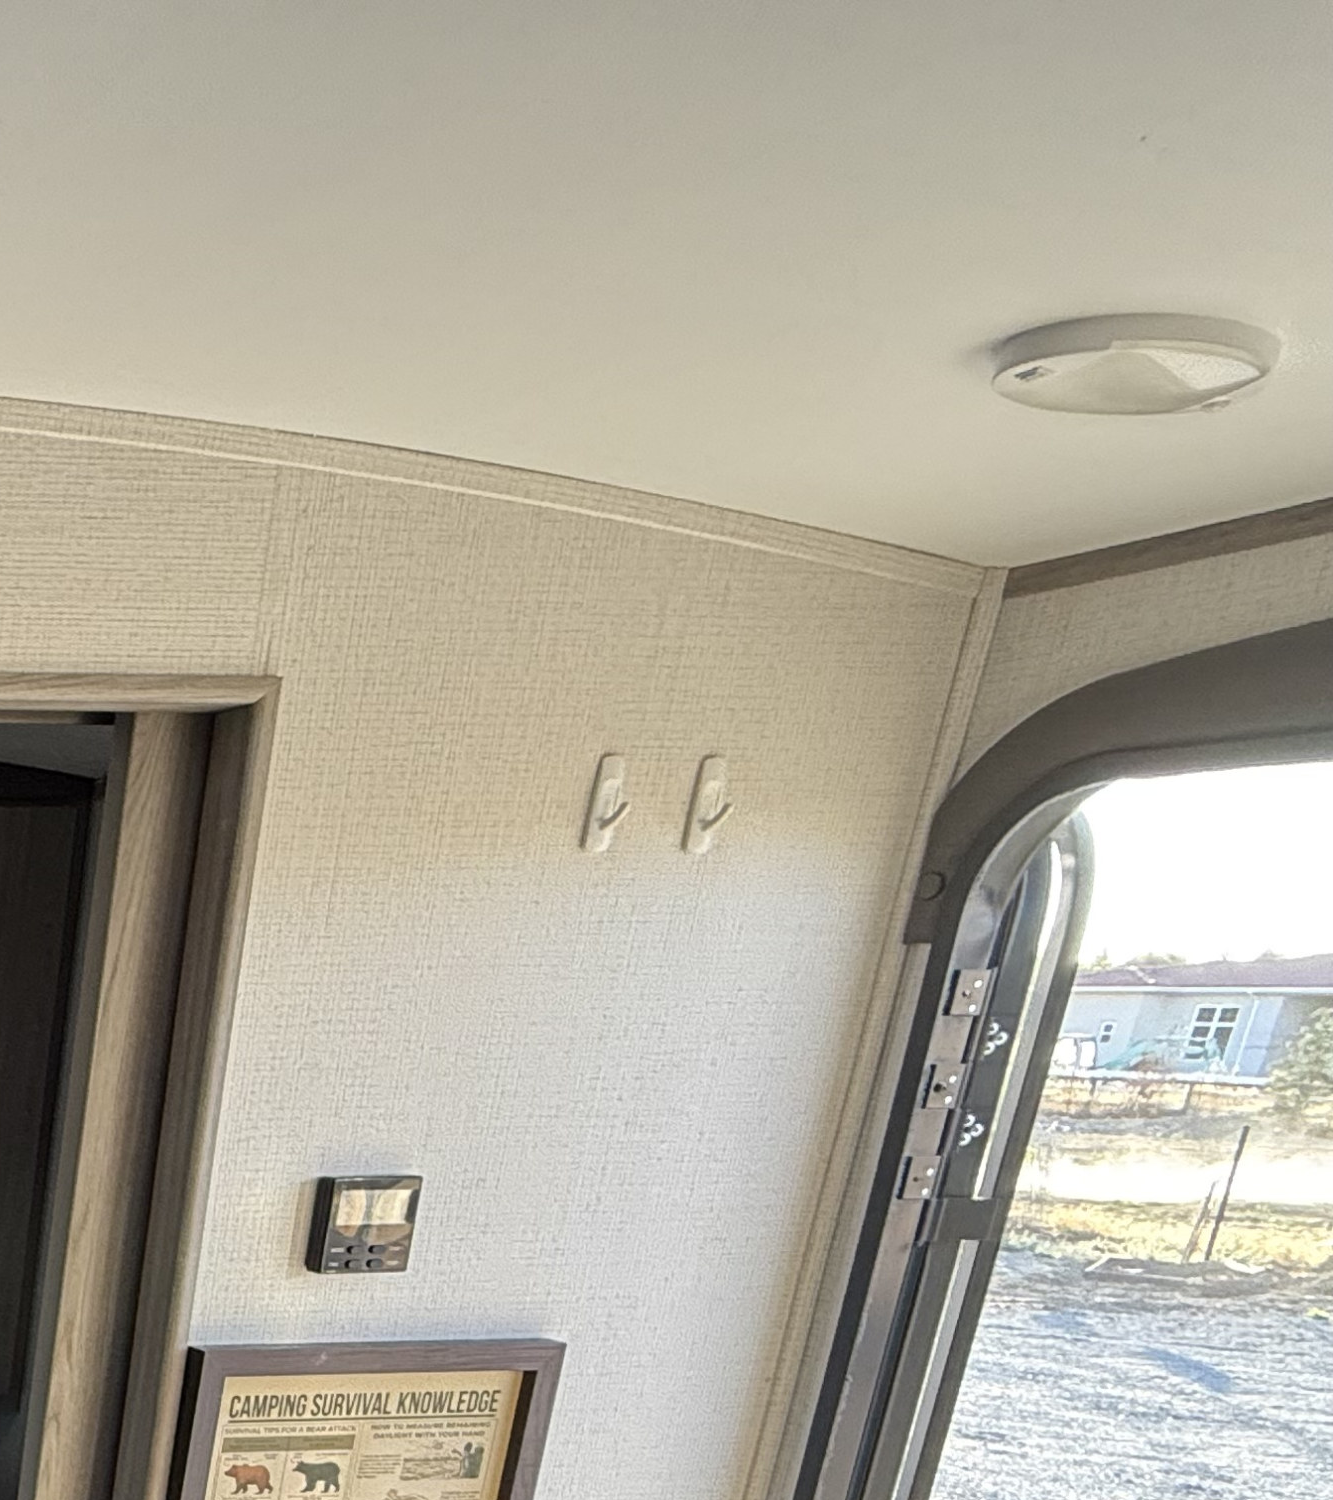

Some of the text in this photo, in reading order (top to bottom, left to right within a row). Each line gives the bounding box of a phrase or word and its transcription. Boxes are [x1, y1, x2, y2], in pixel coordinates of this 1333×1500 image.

[229, 1389, 501, 1418] CAMPING SURVIVAL KNOWLEDGE
